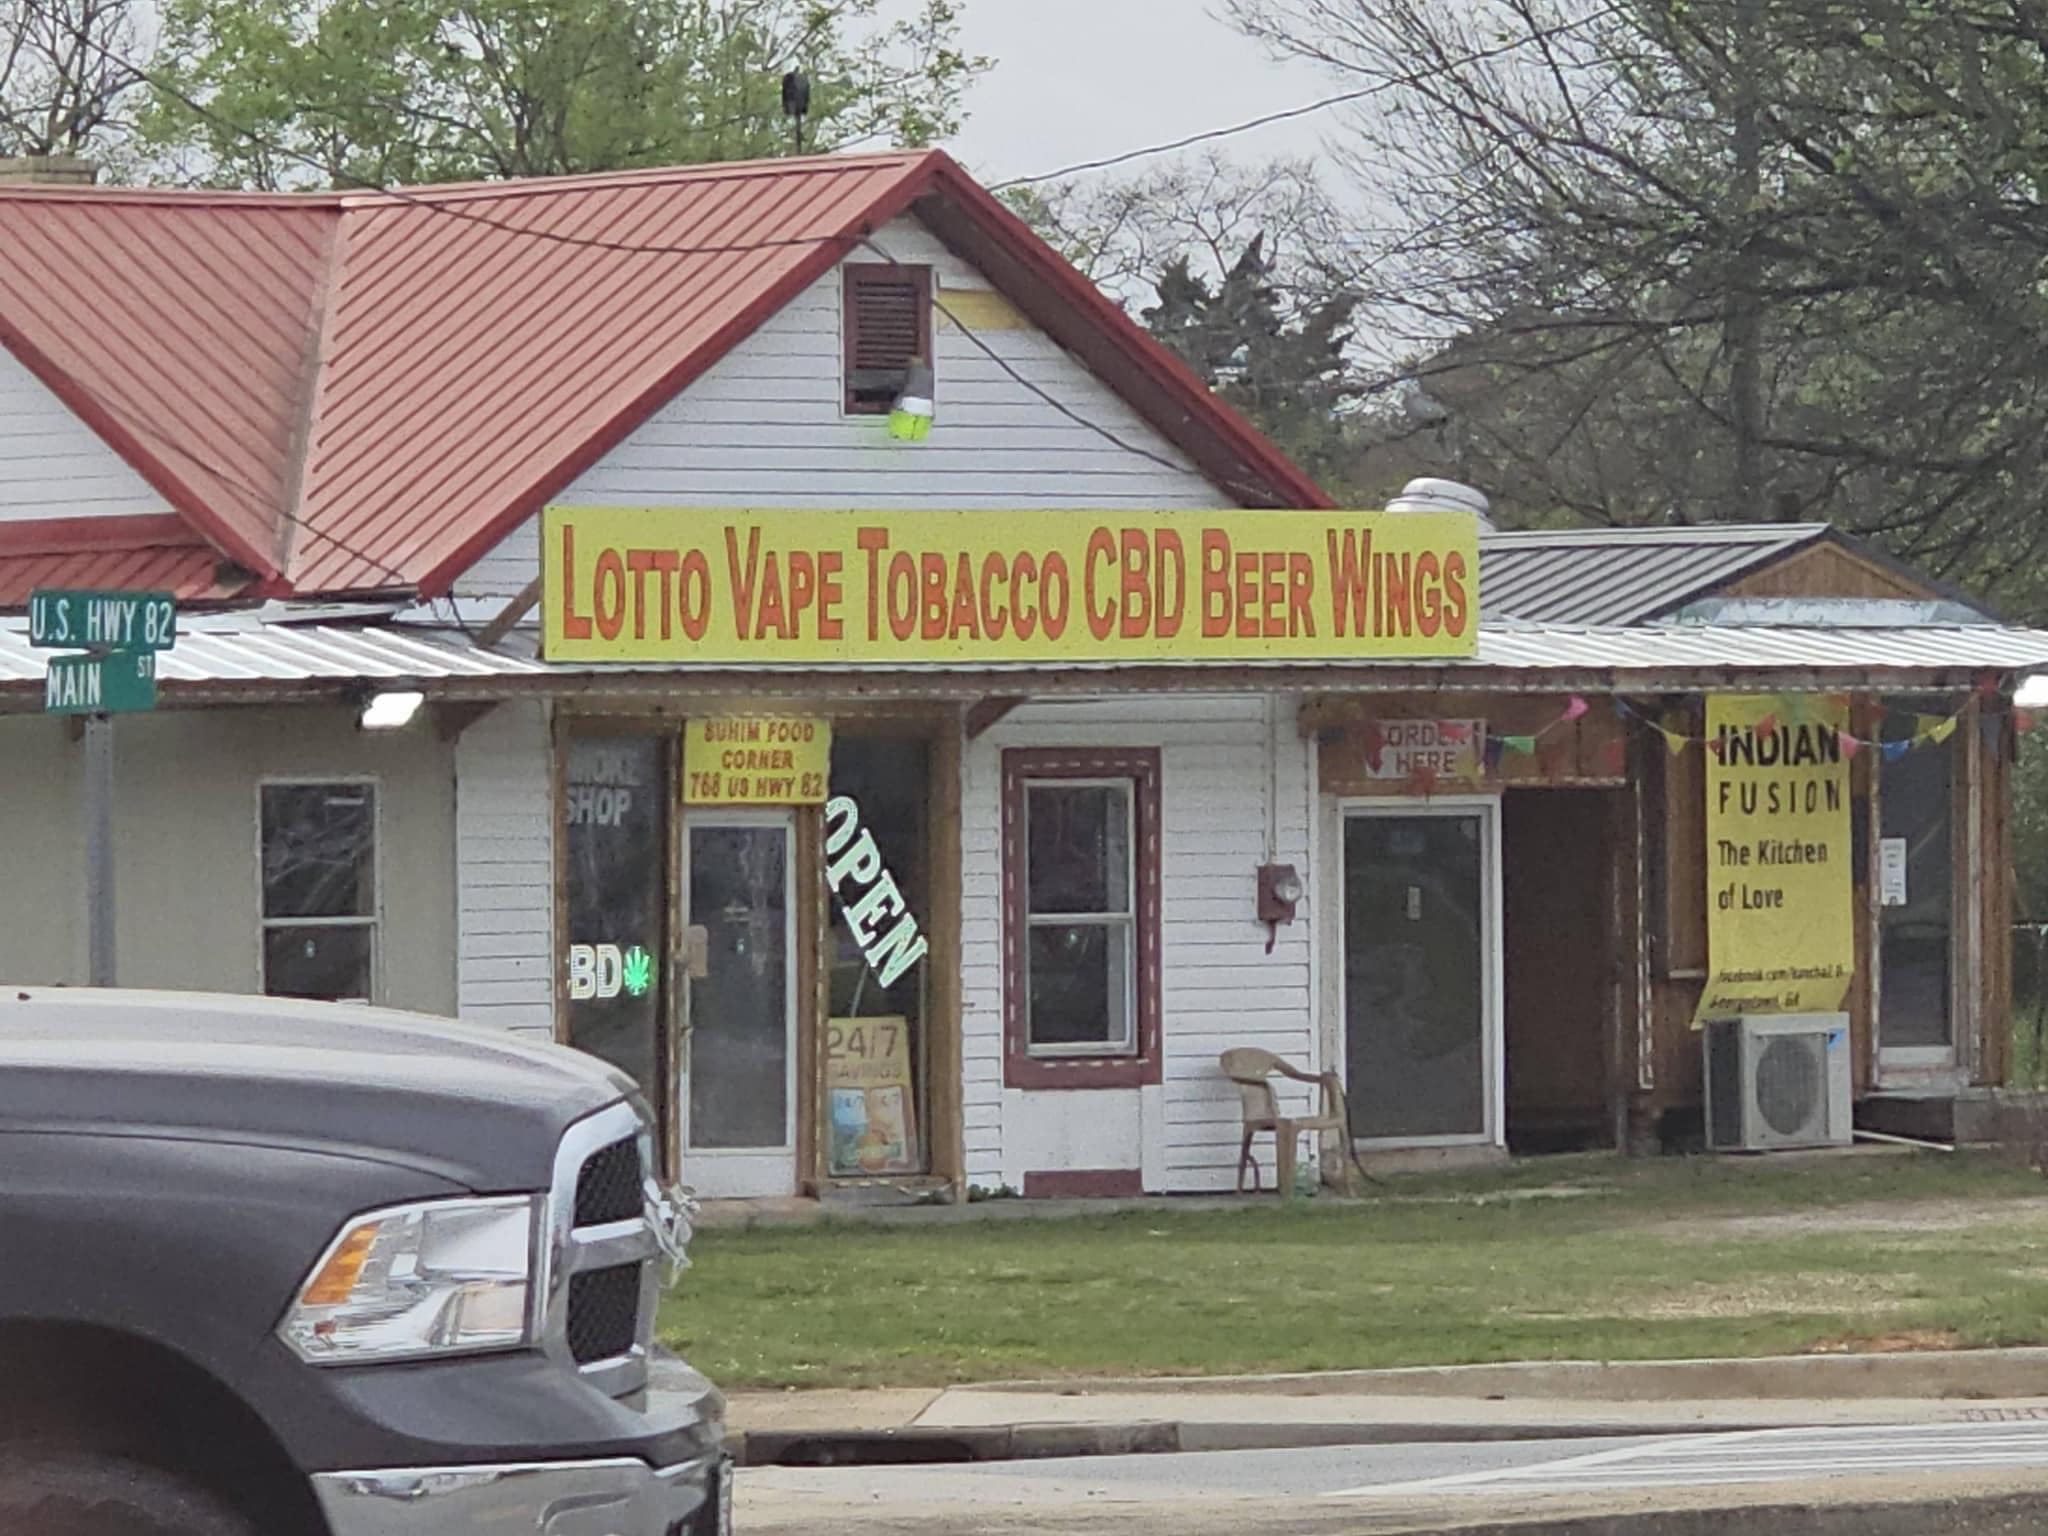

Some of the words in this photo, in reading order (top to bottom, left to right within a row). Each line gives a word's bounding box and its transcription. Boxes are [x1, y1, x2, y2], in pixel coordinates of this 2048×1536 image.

[563, 524, 712, 641] LOTTO
[724, 526, 844, 641] VAPE
[857, 527, 1070, 641] TOBACCO
[1085, 526, 1186, 641] CBD
[1201, 528, 1316, 639] BEER
[1327, 528, 1468, 638] WINGS
[31, 597, 76, 642] U.S.
[87, 599, 137, 643] HWY
[145, 601, 174, 645] 82
[47, 663, 101, 709] MAIN
[137, 655, 153, 679] ST
[767, 720, 816, 743] FOOD
[1717, 723, 1840, 767] INDIAN
[721, 749, 794, 770] CORNER
[1396, 751, 1457, 774] HERE
[564, 786, 633, 827] SHOP
[727, 776, 749, 799] US
[755, 776, 797, 799] HWY
[1719, 779, 1841, 815] FUSION
[1717, 839, 1750, 867] The
[1757, 840, 1829, 866] Kitchen
[825, 795, 929, 989] OPEN
[1717, 882, 1736, 910] of
[1741, 884, 1784, 910] Love
[566, 943, 624, 1000] BD
